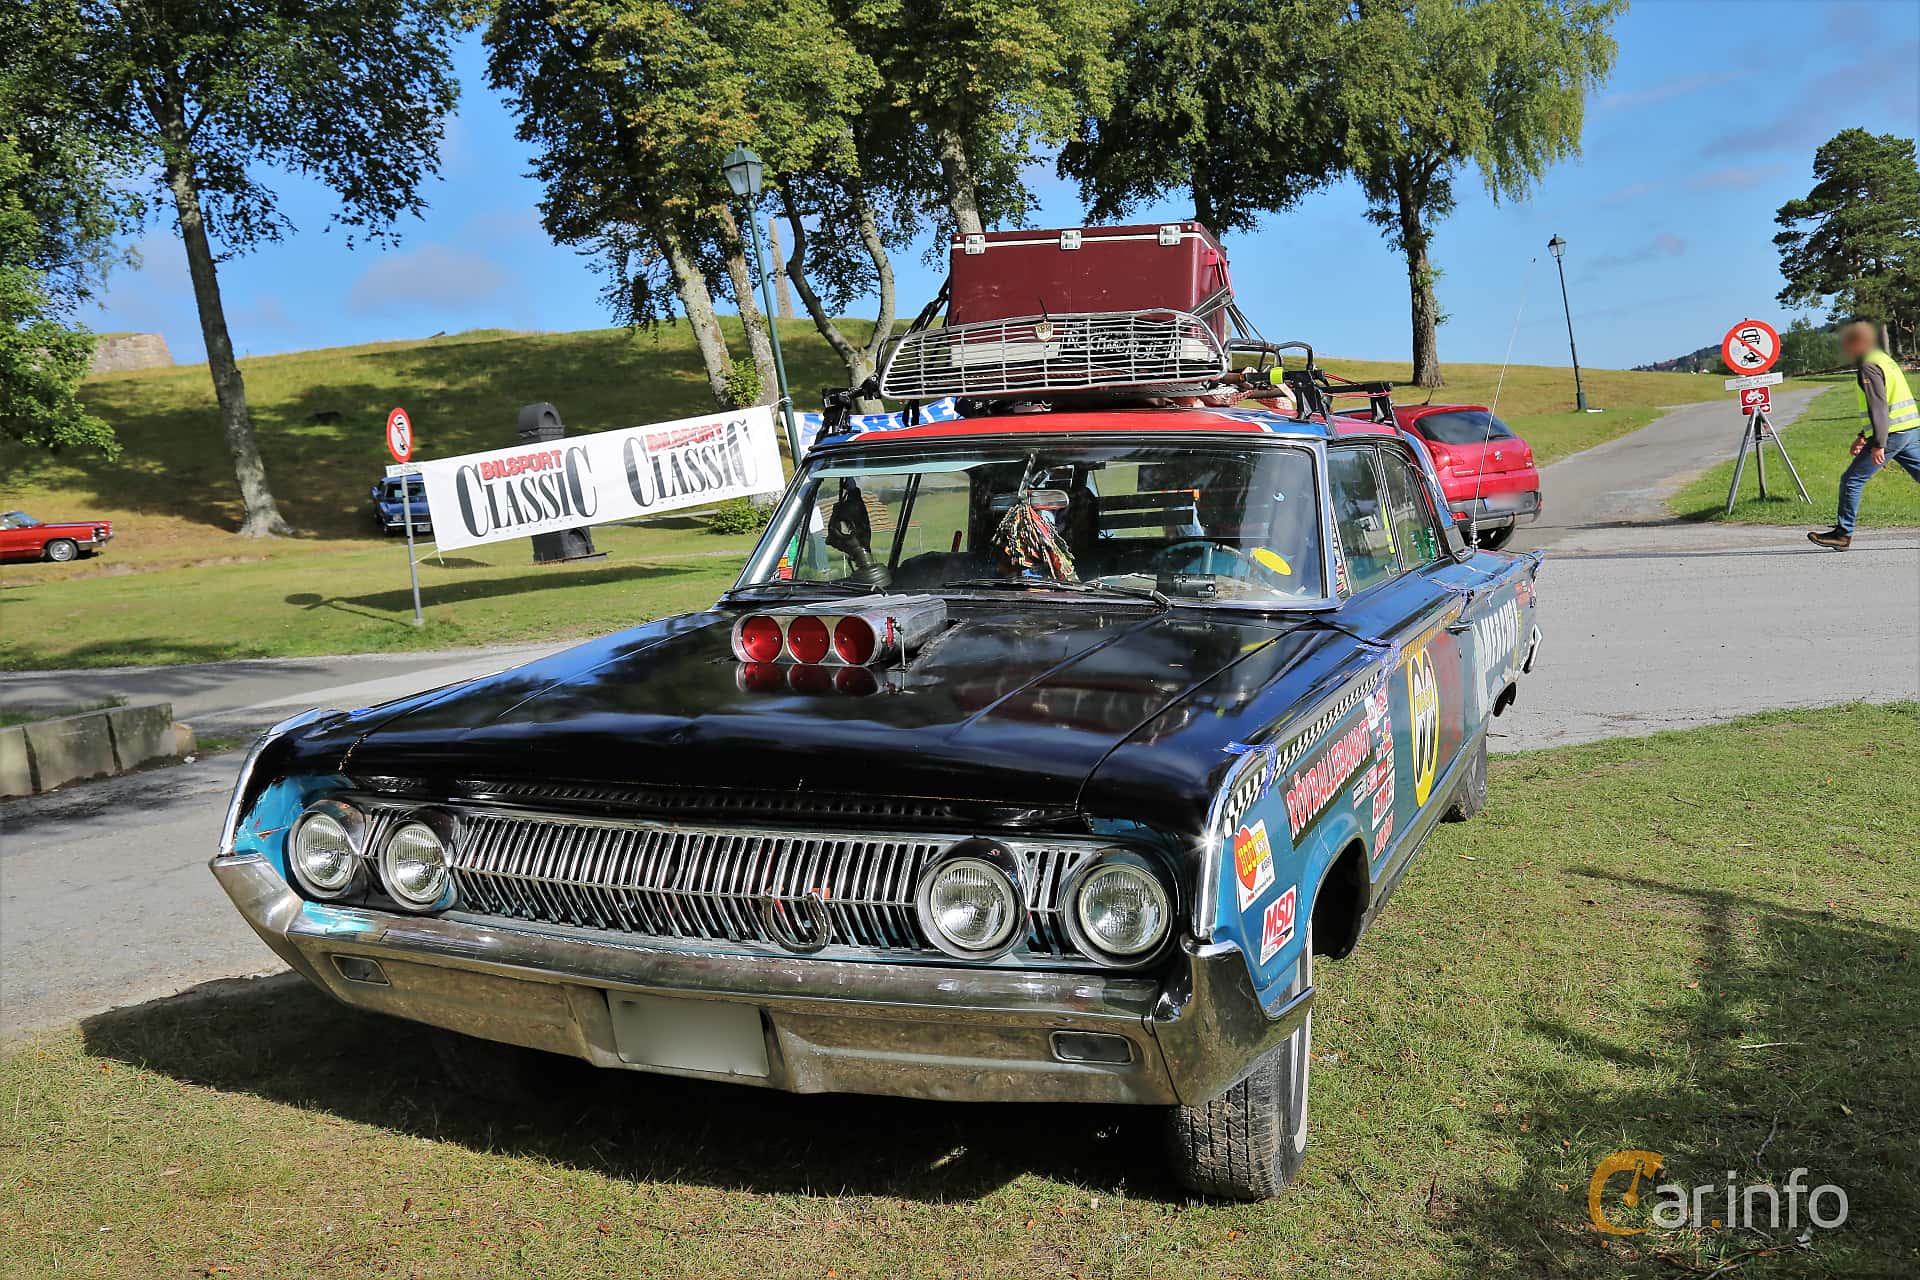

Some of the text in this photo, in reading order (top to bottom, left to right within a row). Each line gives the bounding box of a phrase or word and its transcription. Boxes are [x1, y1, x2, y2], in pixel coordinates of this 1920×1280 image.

[623, 419, 758, 508] CLASSIC
[647, 423, 723, 451] BILSPORT
[456, 446, 598, 538] CLASSIC
[480, 449, 564, 481] BILSPORT
[1263, 890, 1295, 945] MSD
